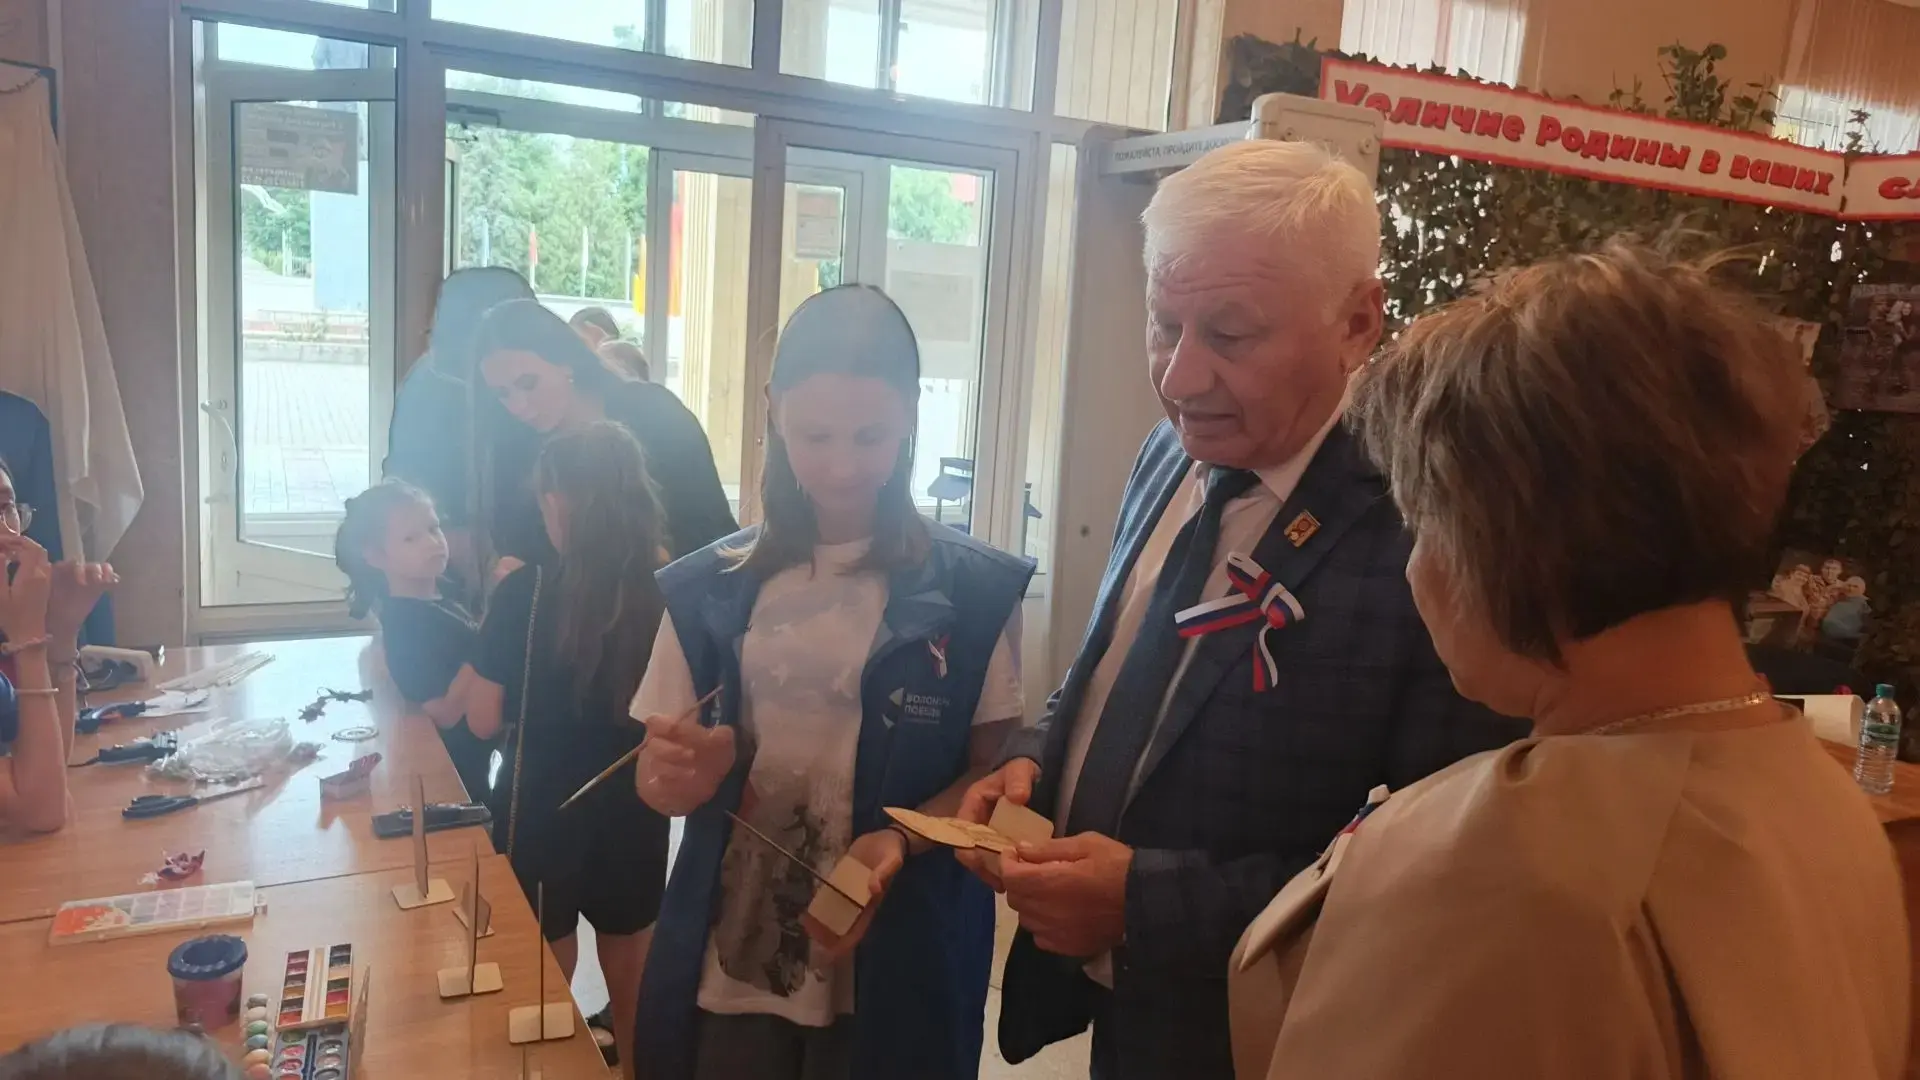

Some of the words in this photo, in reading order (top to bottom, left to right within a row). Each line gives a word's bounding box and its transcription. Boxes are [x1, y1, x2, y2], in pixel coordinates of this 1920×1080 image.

[1536, 114, 1690, 170] Родины
[1698, 149, 1720, 175] в
[1729, 154, 1834, 196] ваших
